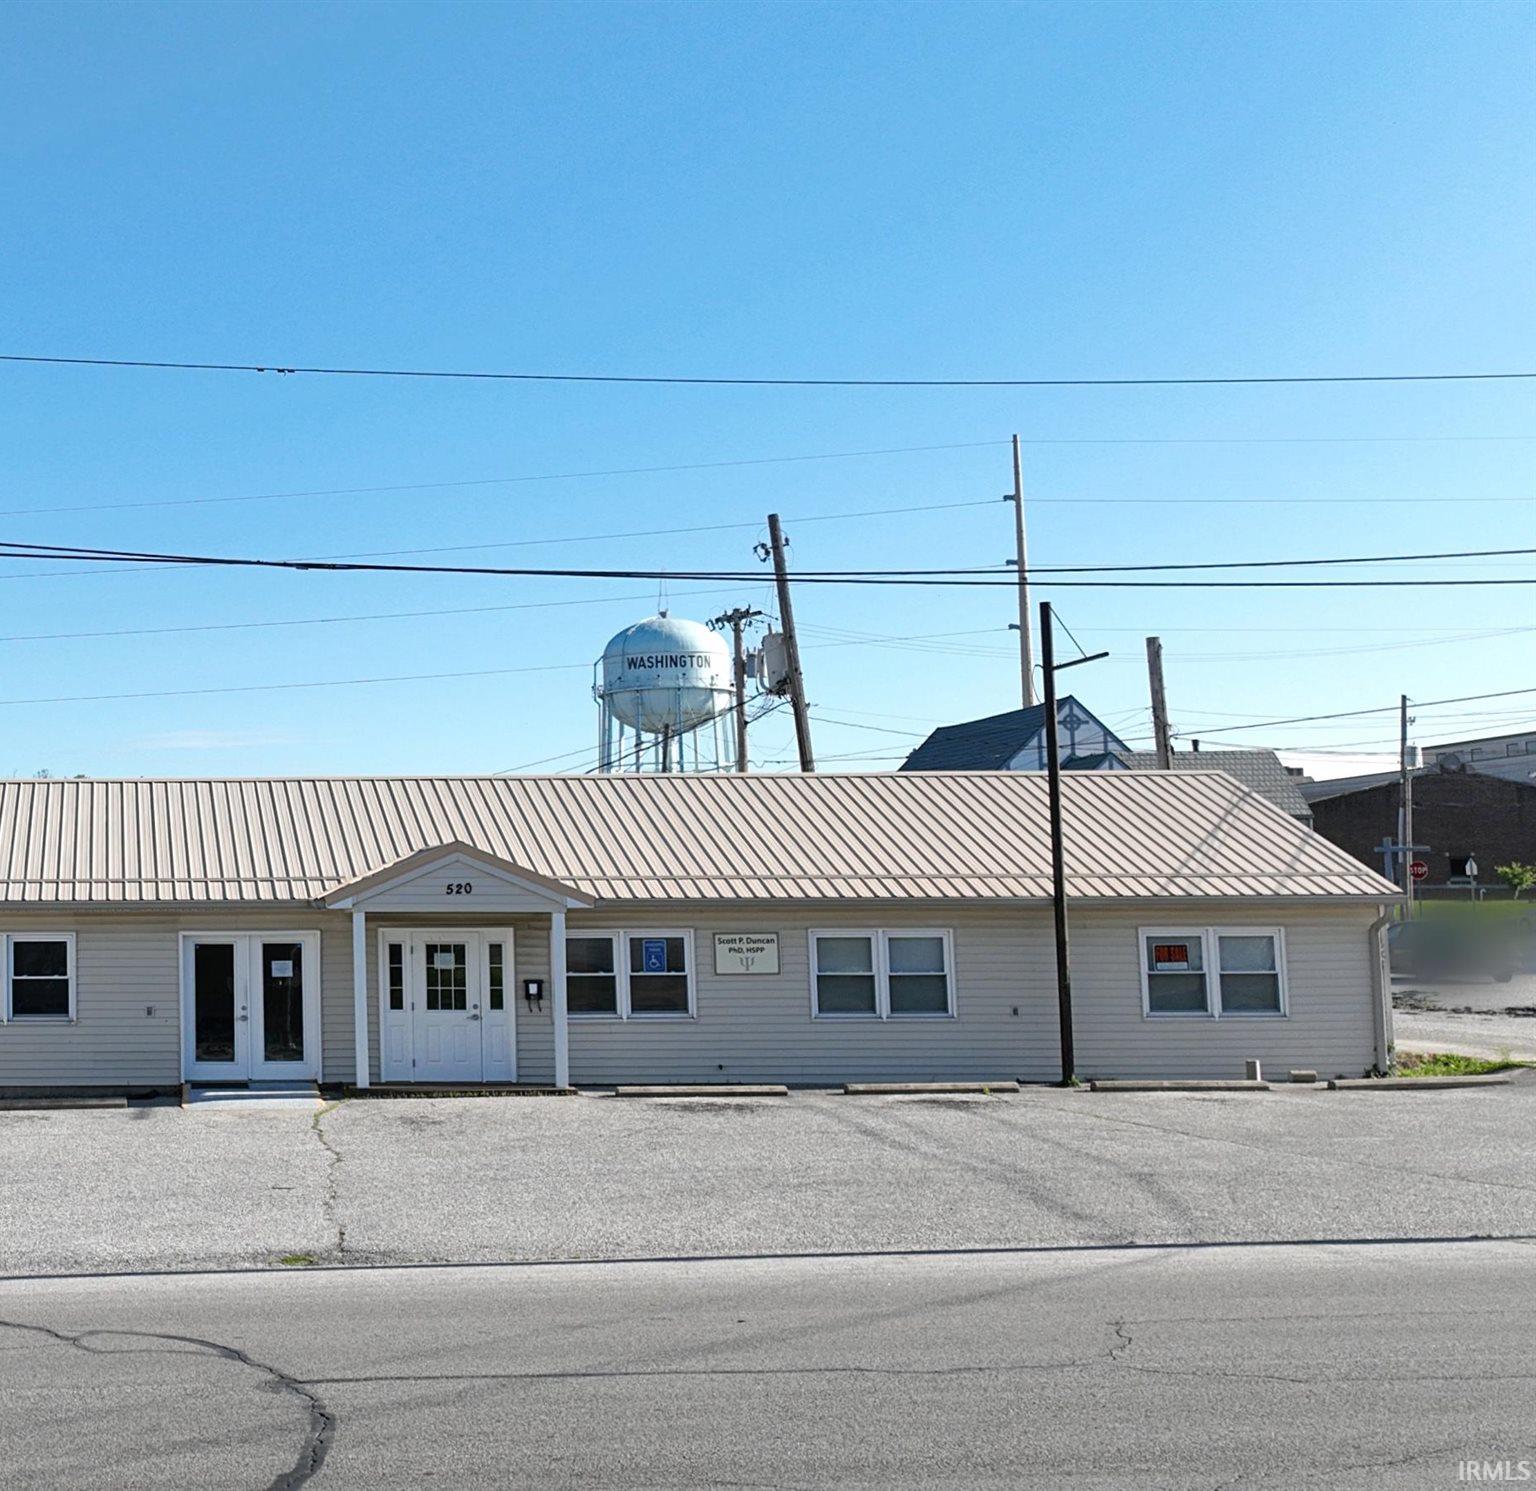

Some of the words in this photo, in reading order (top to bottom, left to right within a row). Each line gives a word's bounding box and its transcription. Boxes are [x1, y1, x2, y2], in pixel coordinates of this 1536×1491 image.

[626, 655, 711, 670] WASHINGTON
[446, 882, 472, 895] 520
[717, 937, 737, 945] Scott
[1156, 946, 1169, 961] FOR
[1170, 946, 1187, 961] SALE
